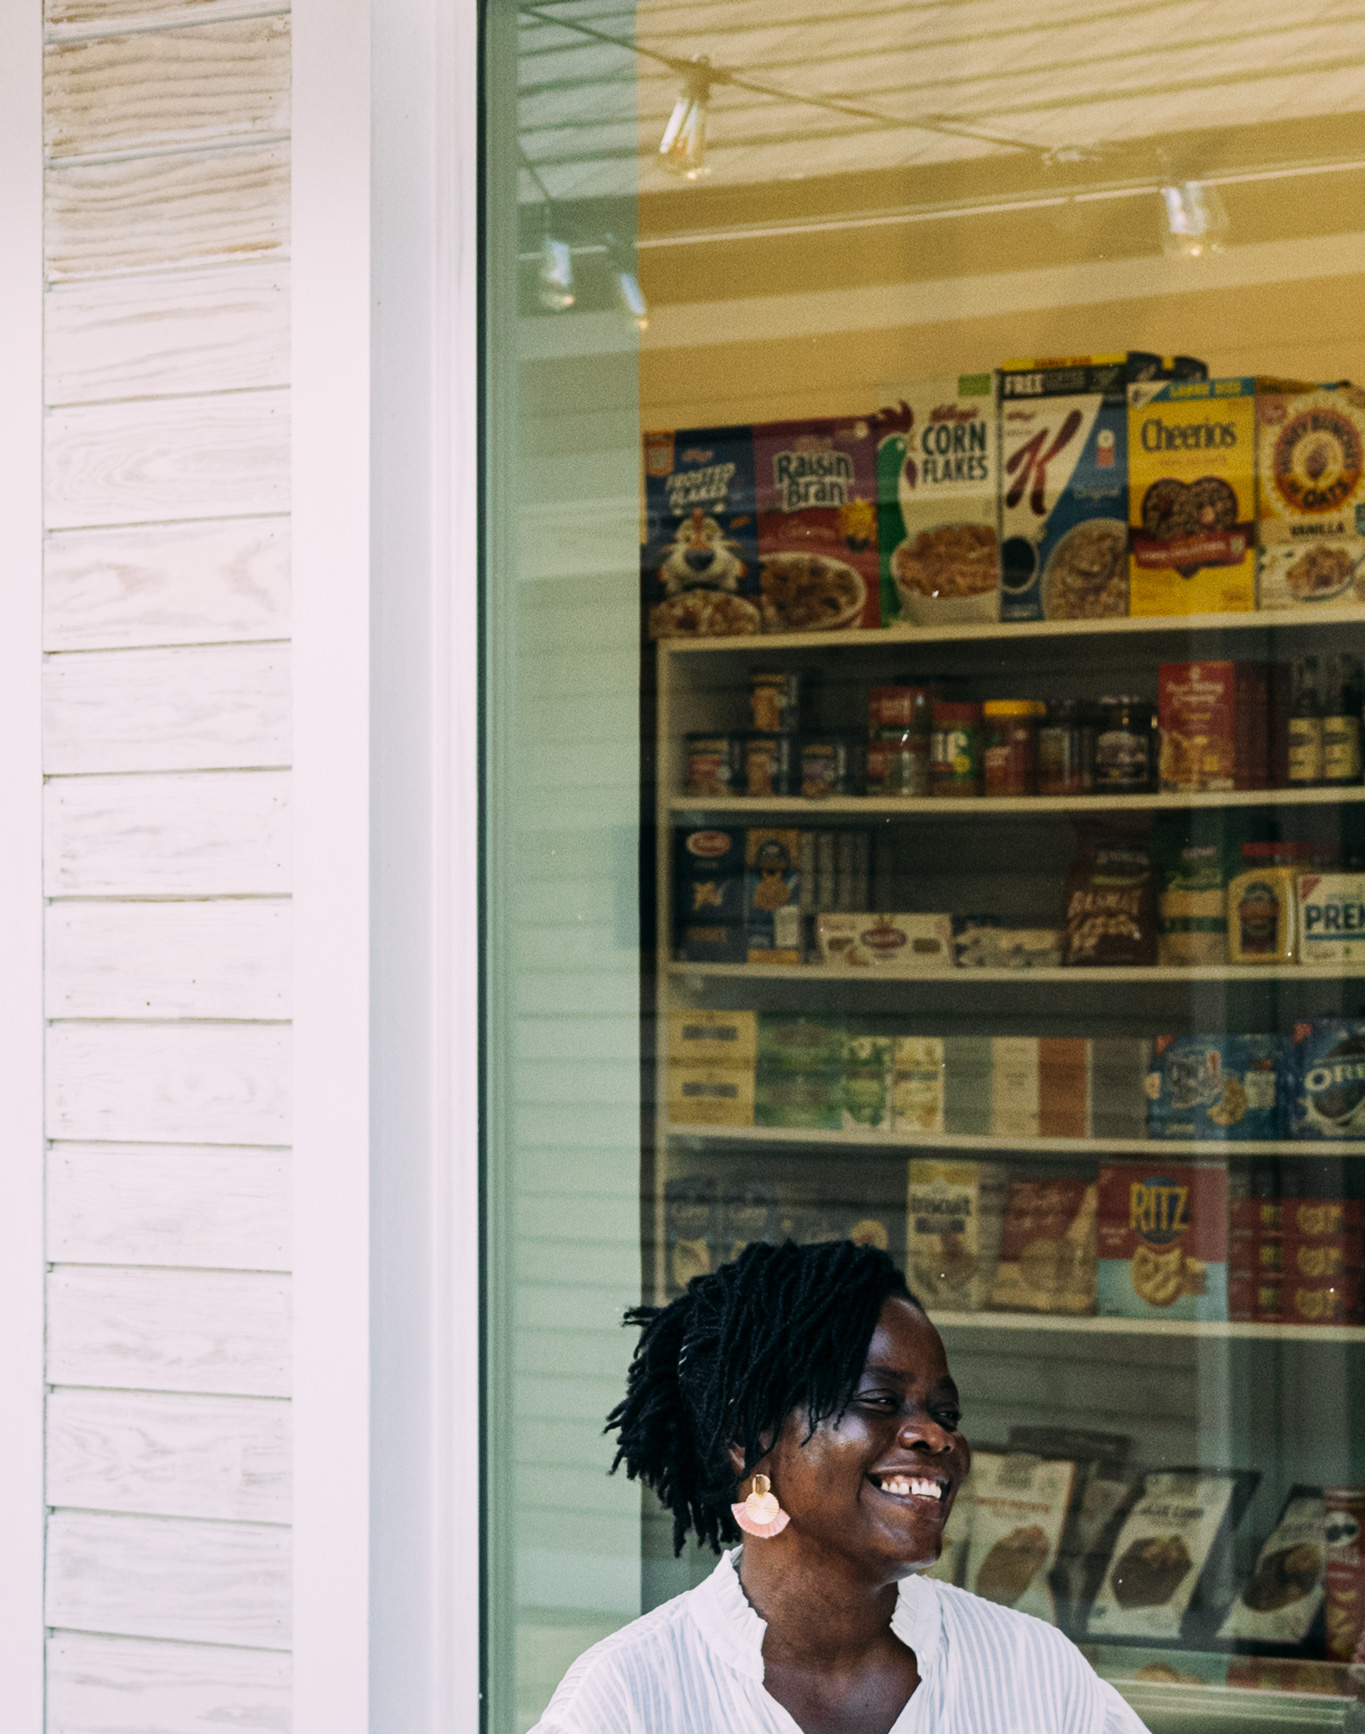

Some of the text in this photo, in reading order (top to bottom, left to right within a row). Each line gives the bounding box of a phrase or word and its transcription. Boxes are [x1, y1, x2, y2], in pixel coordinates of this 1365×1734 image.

[922, 420, 986, 456] CORN
[1140, 415, 1238, 453] Cheerios
[776, 454, 851, 485] Raisin
[923, 455, 989, 484] FLAKES
[788, 481, 843, 507] Bran
[1129, 1181, 1190, 1232] RITZ
